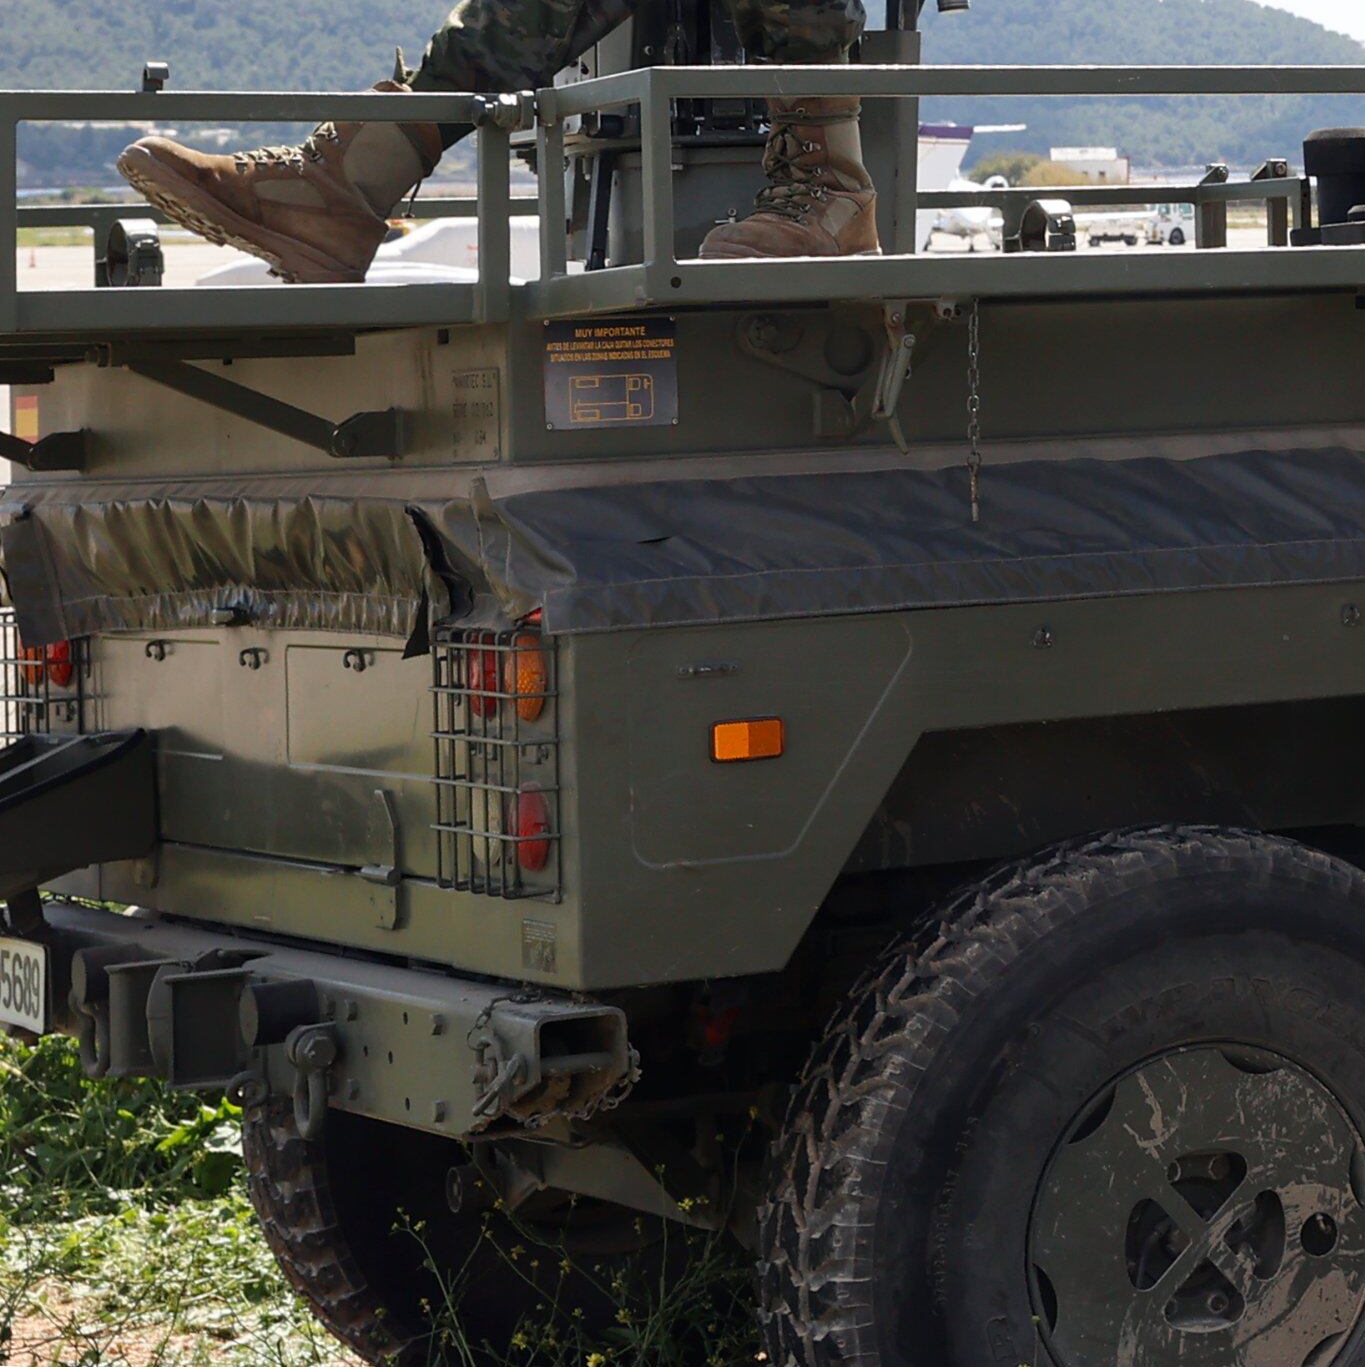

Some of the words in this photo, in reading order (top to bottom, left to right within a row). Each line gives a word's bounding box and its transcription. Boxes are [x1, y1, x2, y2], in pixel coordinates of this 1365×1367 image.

[575, 328, 593, 338] MUY
[594, 326, 646, 337] IMPORTANTE
[546, 342, 562, 351] ANTES
[563, 342, 569, 351] DE
[595, 341, 601, 349] LA
[602, 340, 614, 349] CAJA
[632, 339, 642, 348] LOS
[574, 352, 582, 361] EN
[582, 352, 591, 362] LAS
[634, 350, 641, 360] EN
[641, 350, 647, 359] EL
[0, 949, 40, 1019] 5689
